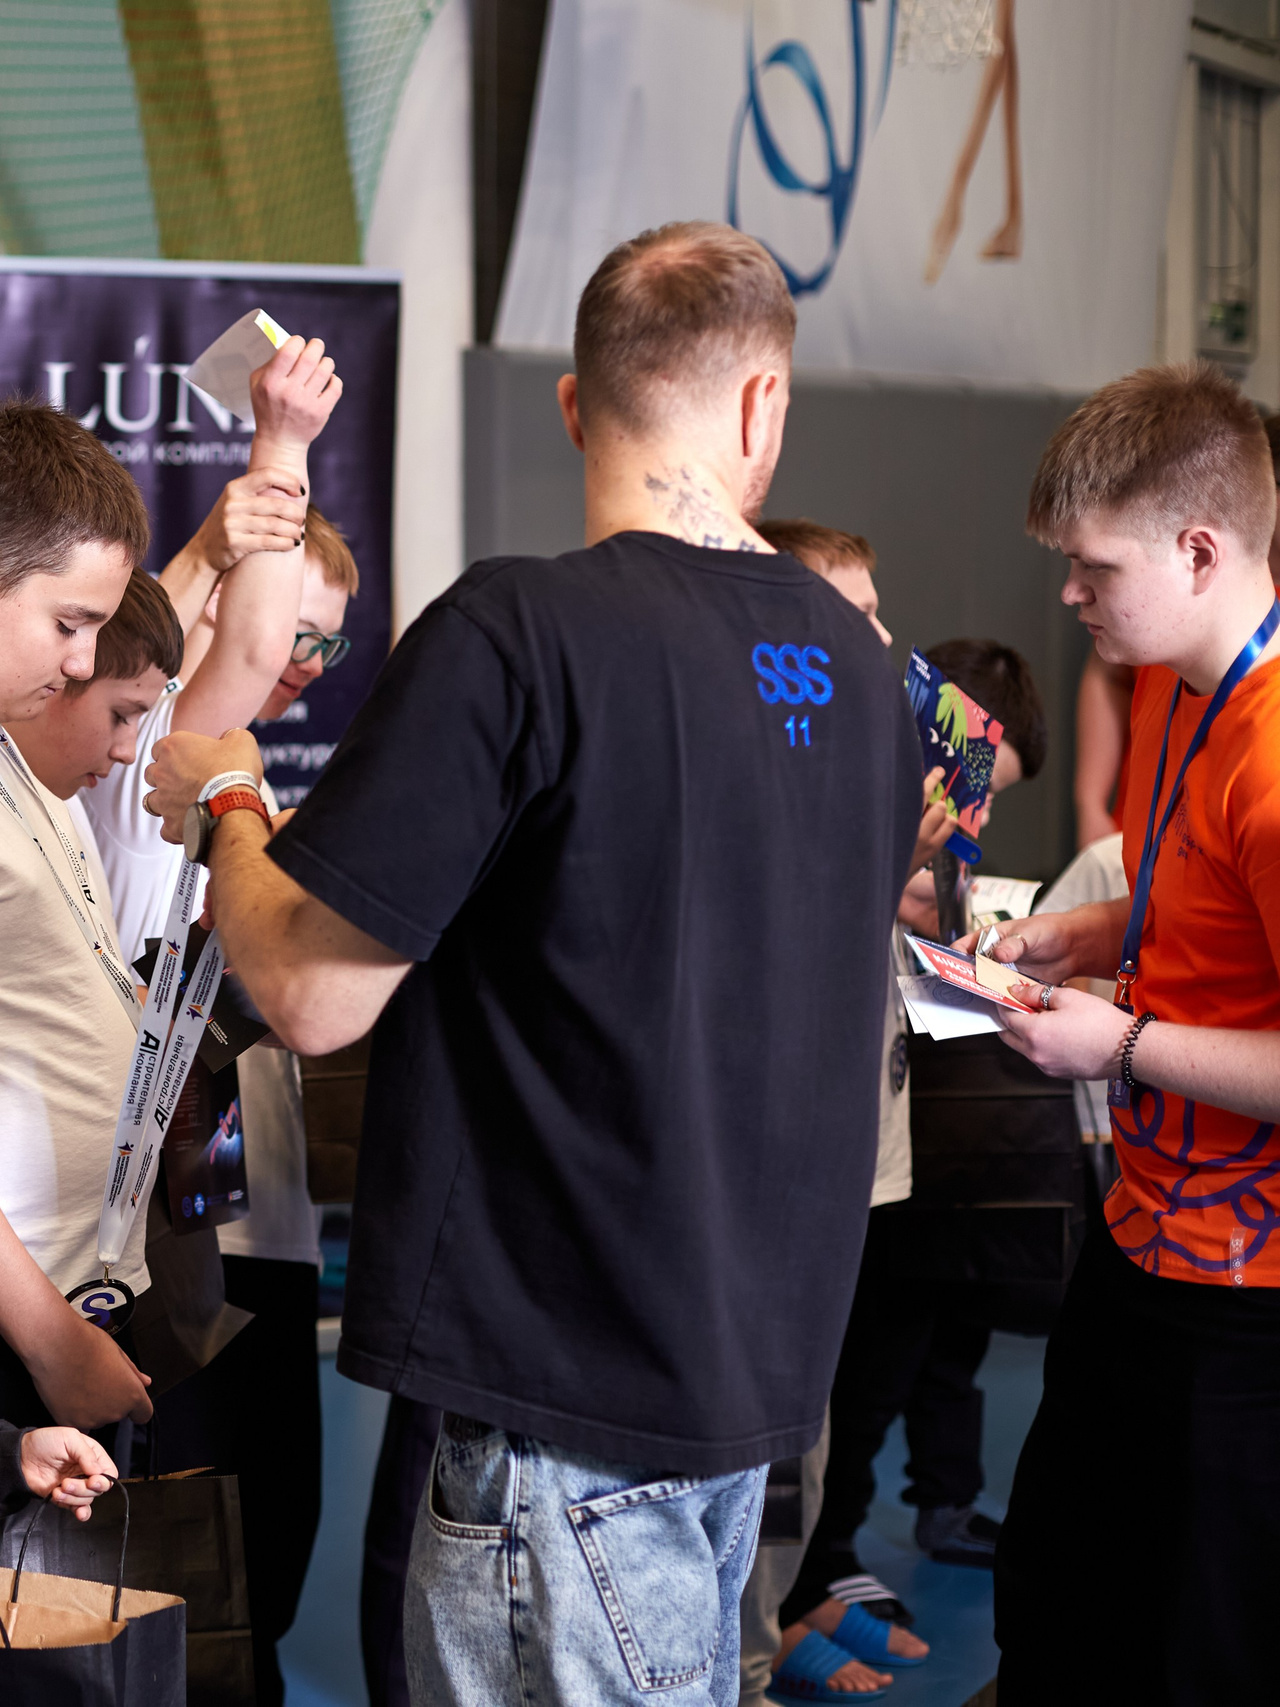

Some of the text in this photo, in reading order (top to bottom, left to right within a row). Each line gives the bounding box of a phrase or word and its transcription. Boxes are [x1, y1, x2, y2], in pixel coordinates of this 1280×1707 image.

[43, 335, 257, 433] LÚN
[751, 642, 834, 705] SSS
[784, 714, 811, 748] 11
[177, 860, 191, 896] пания
[180, 863, 198, 924] оительная
[126, 1052, 146, 1105] компания
[133, 1055, 157, 1126] строительная
[157, 1034, 185, 1105] строительная
[165, 1060, 188, 1112] компания
